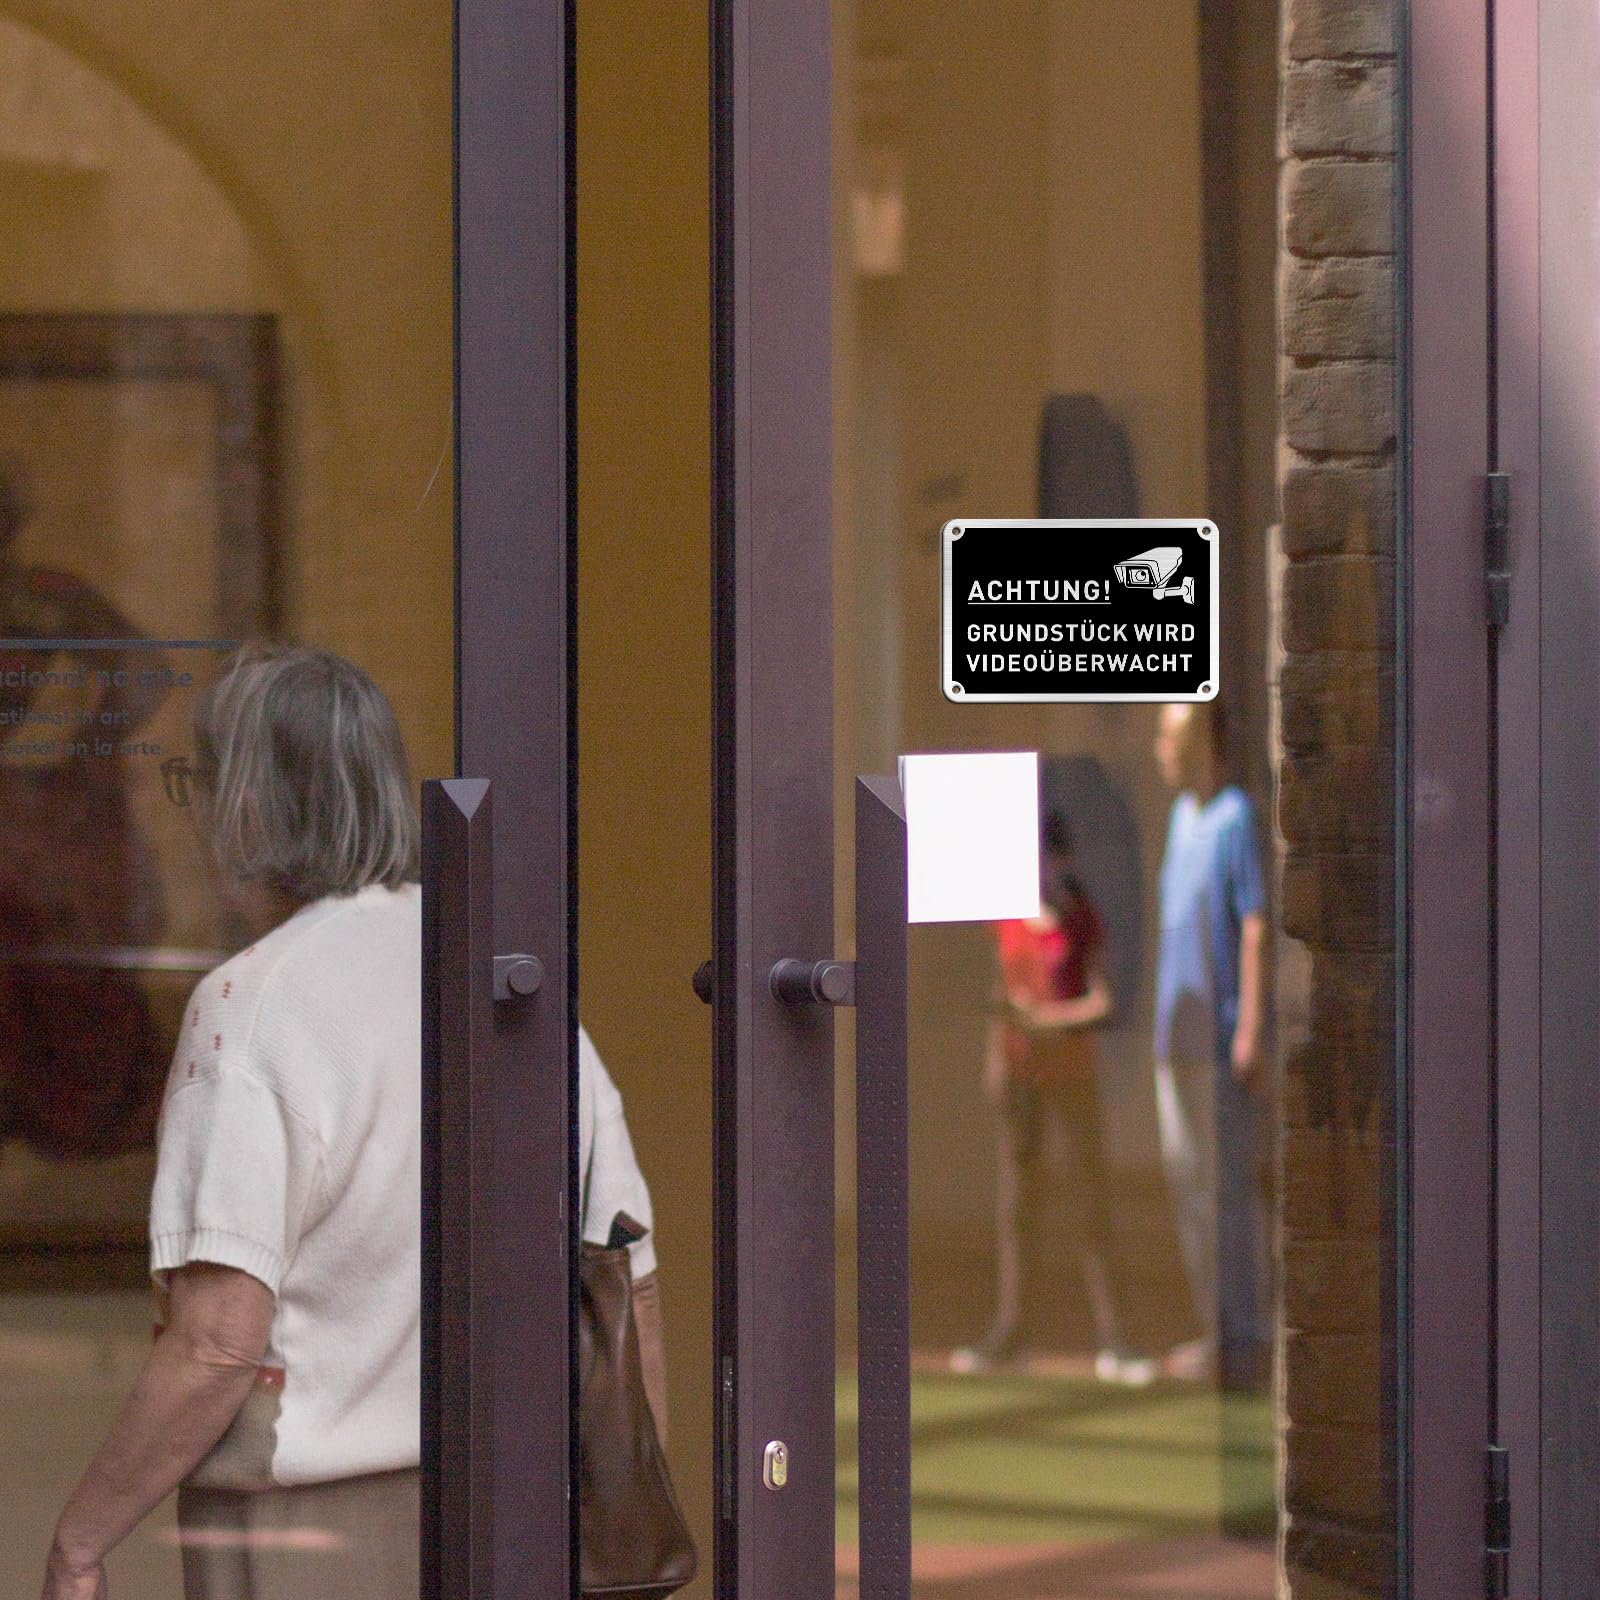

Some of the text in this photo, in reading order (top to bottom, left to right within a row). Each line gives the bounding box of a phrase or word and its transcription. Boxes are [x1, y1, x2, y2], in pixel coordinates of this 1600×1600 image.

[967, 579, 1111, 601] ACHTUNG!
[967, 619, 1195, 642] GRUNDSTÜCK WIRD
[966, 649, 1193, 672] VIDEOÜBERWACHT
[0, 664, 87, 687] cional
[137, 667, 192, 687] arte
[100, 708, 129, 723] art
[95, 735, 112, 754] la
